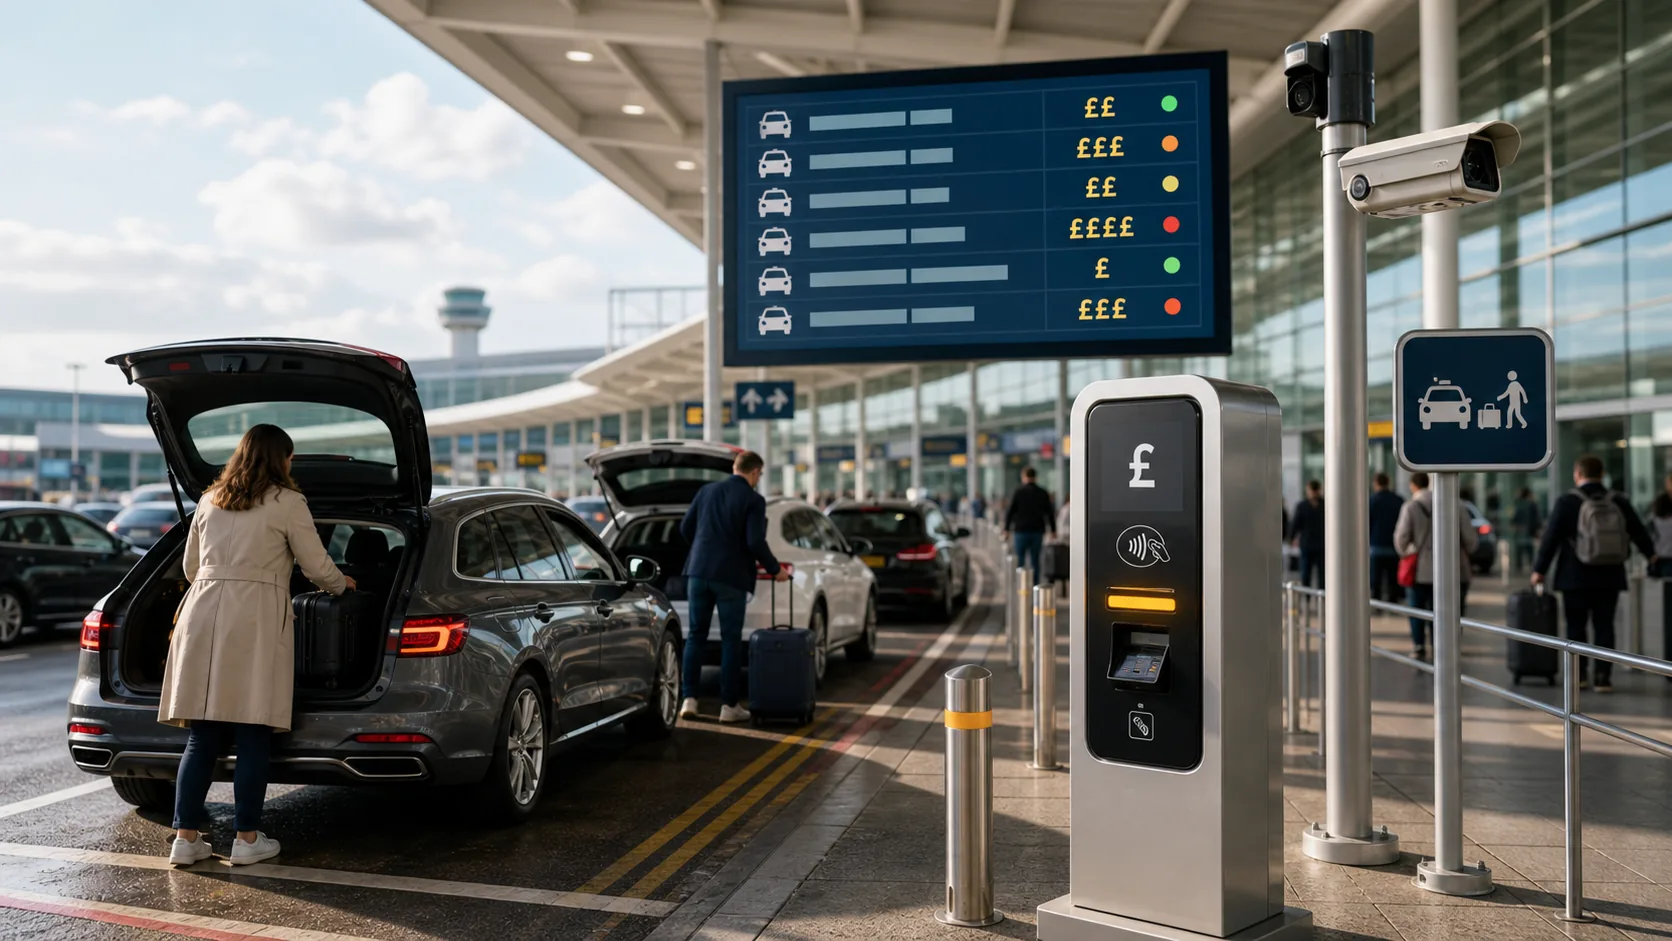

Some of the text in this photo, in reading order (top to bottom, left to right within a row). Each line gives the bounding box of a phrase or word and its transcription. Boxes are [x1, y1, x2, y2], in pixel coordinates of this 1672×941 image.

[1084, 96, 1115, 118] ££
[1077, 136, 1124, 158] £££
[1086, 176, 1117, 198] ££
[1069, 216, 1134, 239] ££££
[1095, 257, 1110, 278] £
[1079, 298, 1127, 320] £££
[1129, 443, 1155, 487] £
